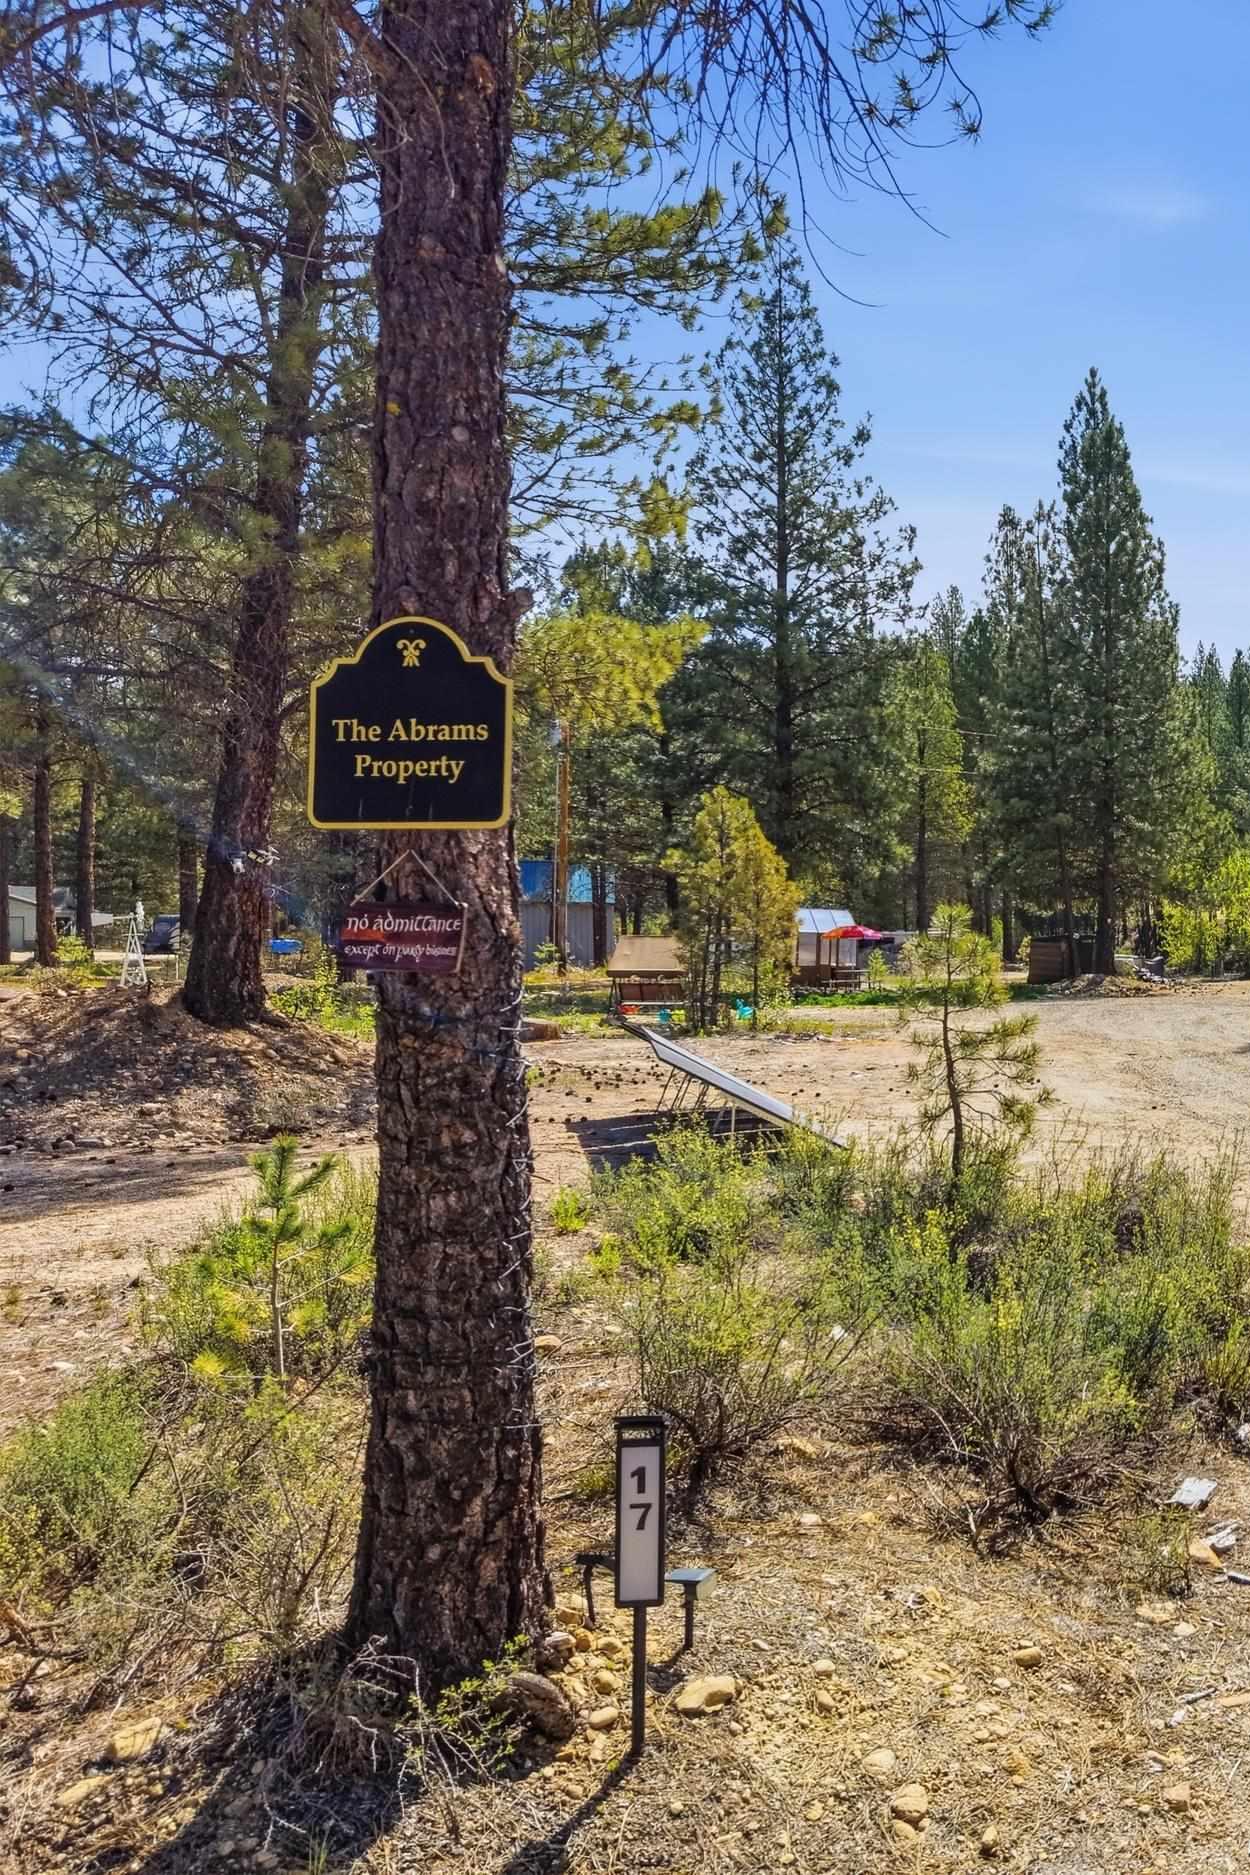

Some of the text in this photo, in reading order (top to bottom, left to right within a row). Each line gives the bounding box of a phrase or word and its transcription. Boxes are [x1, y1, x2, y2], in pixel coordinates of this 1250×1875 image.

[332, 718, 489, 742] The Abrams
[353, 754, 465, 784] Property
